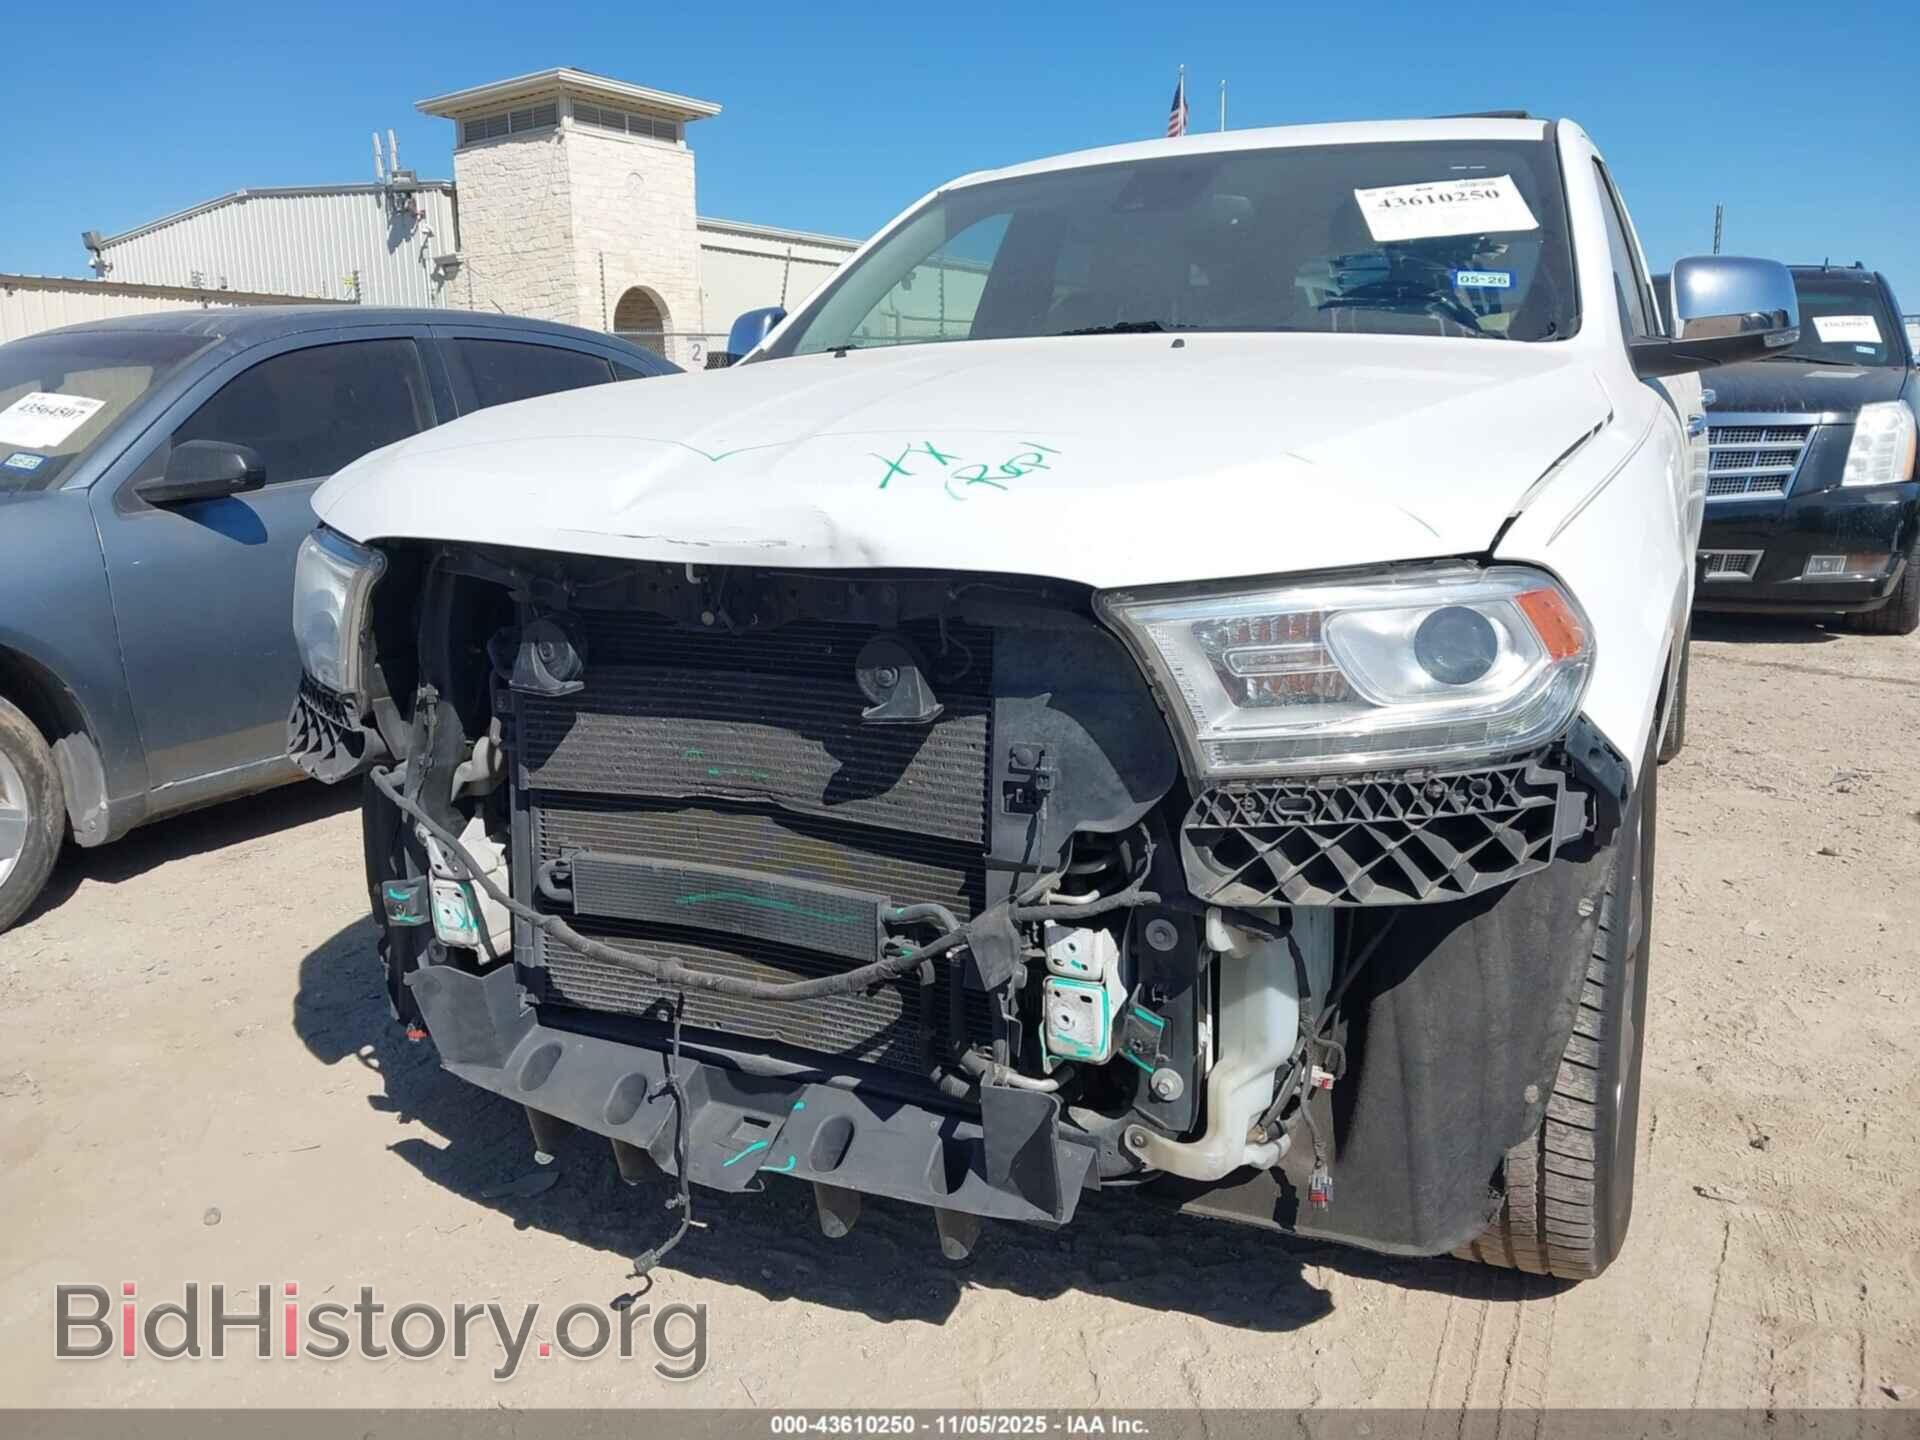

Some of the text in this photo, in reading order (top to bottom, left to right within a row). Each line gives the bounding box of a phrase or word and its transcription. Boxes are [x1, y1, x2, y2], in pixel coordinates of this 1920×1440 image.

[1378, 189, 1501, 209] 43610250
[1459, 274, 1508, 285] 05-26
[691, 343, 702, 362] 2
